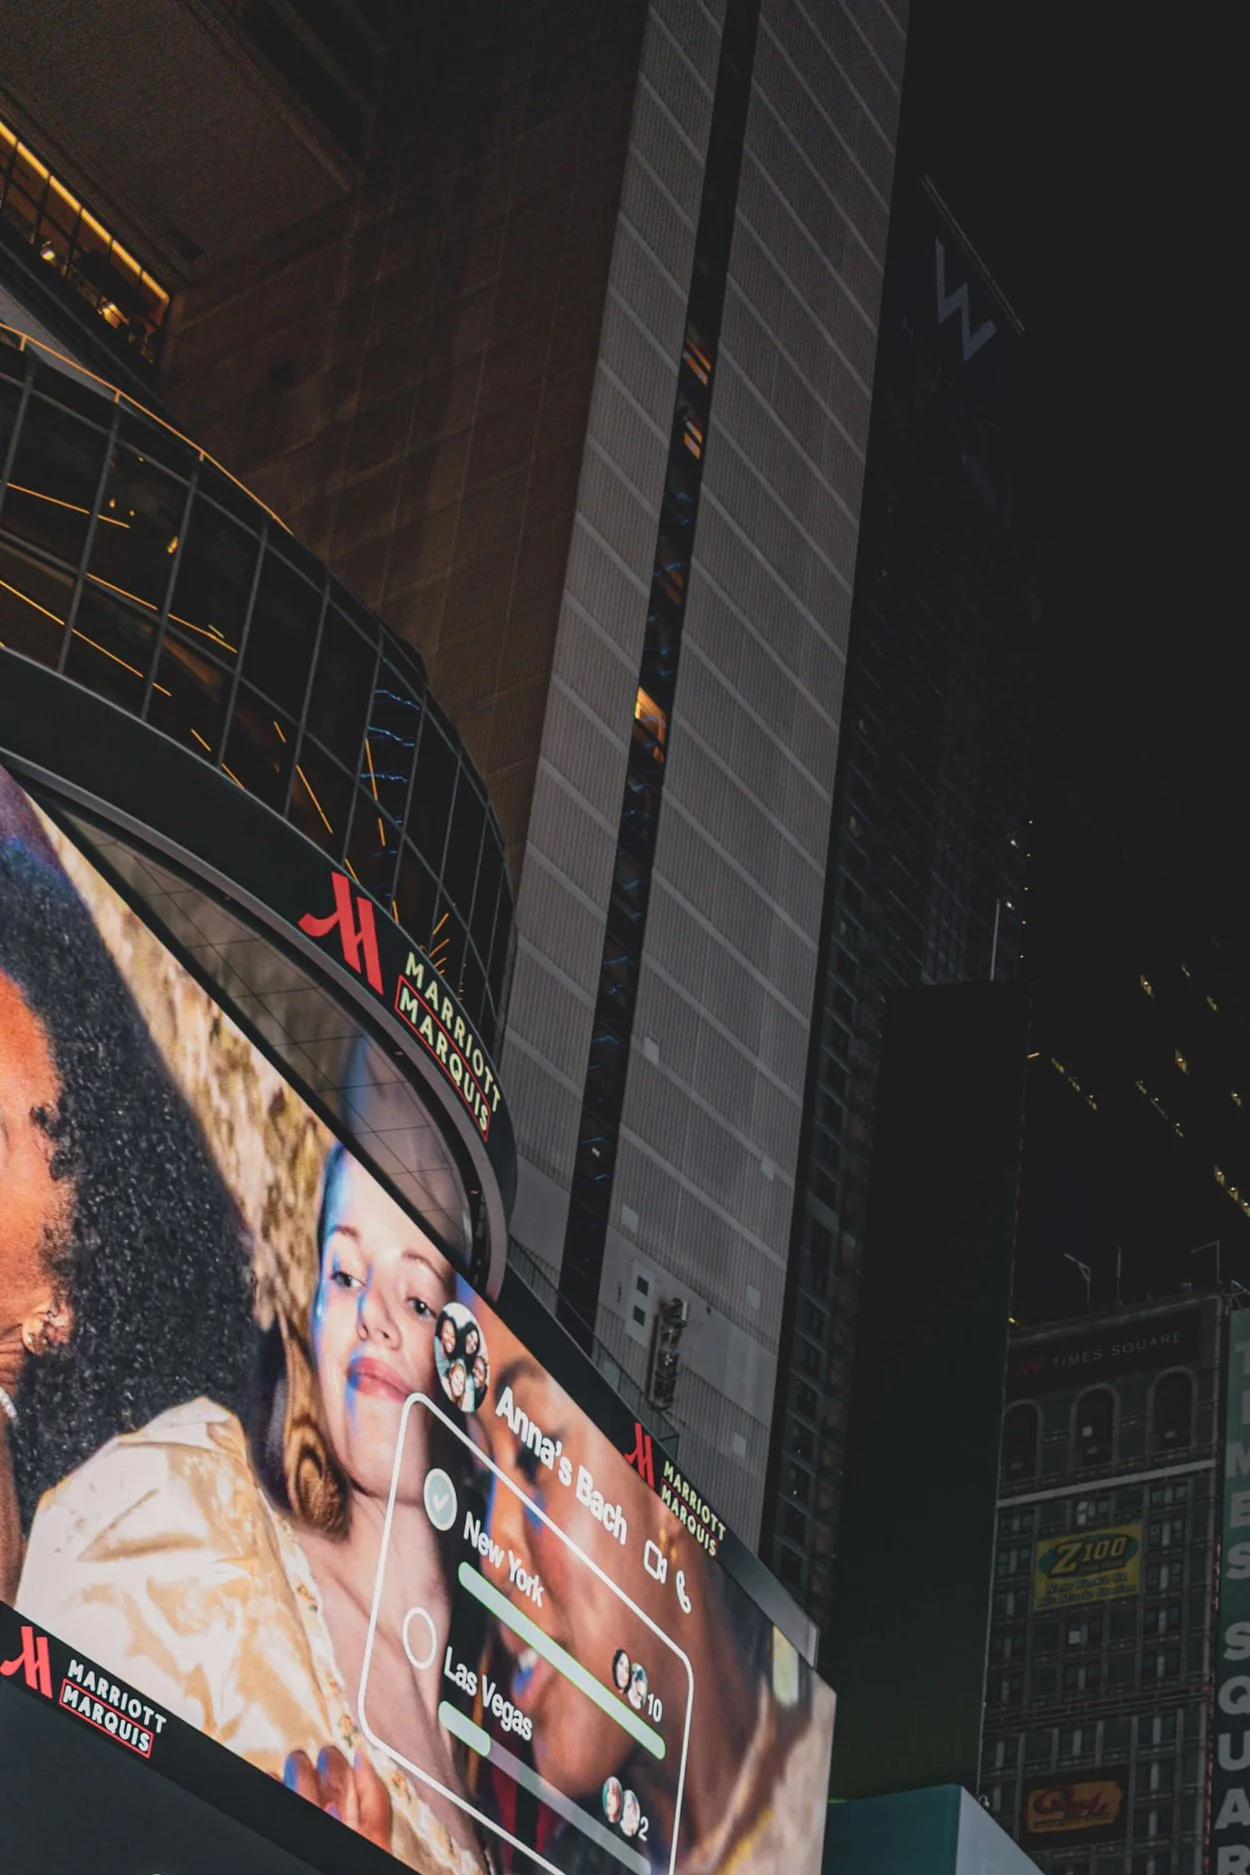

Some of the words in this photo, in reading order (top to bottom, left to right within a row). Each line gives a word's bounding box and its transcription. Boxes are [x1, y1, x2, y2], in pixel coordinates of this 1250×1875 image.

[400, 987, 488, 1131] MARQUIS
[405, 951, 501, 1112] MARRIOTT
[1053, 1349, 1103, 1369] TIMES
[1111, 1331, 1182, 1356] SQUARE
[495, 1386, 573, 1487] Anna's
[576, 1465, 628, 1545] Bach
[664, 1461, 726, 1541] MARRIOTT
[661, 1484, 717, 1557] MARQUIS
[1051, 1536, 1128, 1576] Z100
[463, 1511, 505, 1568] New
[507, 1550, 545, 1607] York
[62, 1685, 150, 1752] MARQUIS
[67, 1659, 167, 1733] MARRIOTT
[444, 1646, 478, 1697] Las
[481, 1675, 532, 1741] Vegas
[648, 1693, 663, 1722] 10
[638, 1816, 649, 1842] 2
